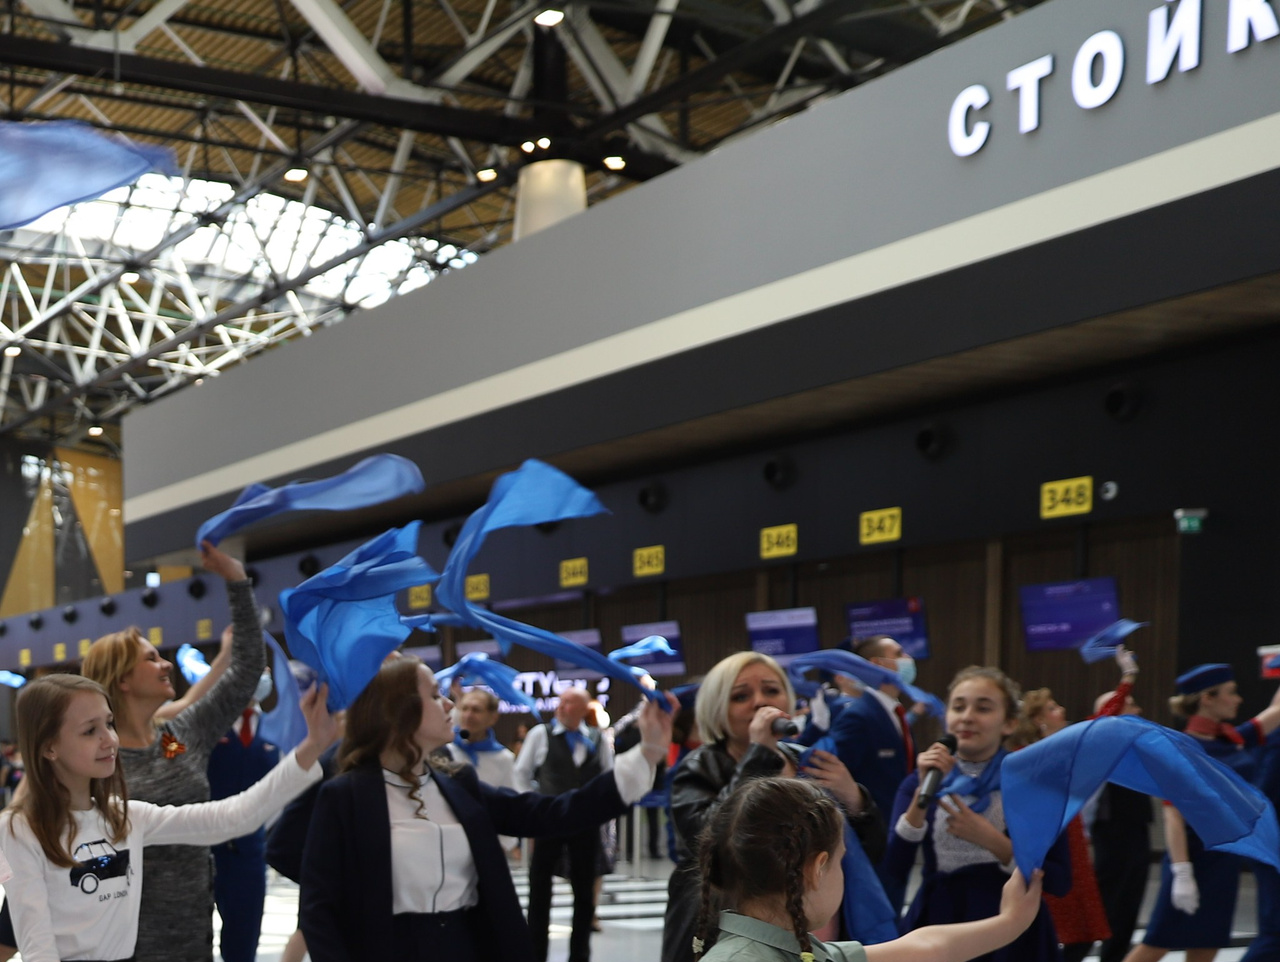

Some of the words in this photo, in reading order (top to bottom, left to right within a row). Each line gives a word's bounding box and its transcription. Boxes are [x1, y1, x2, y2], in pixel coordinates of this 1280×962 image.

[1046, 484, 1088, 511] 348
[863, 513, 898, 538] 347
[764, 528, 796, 553] 346
